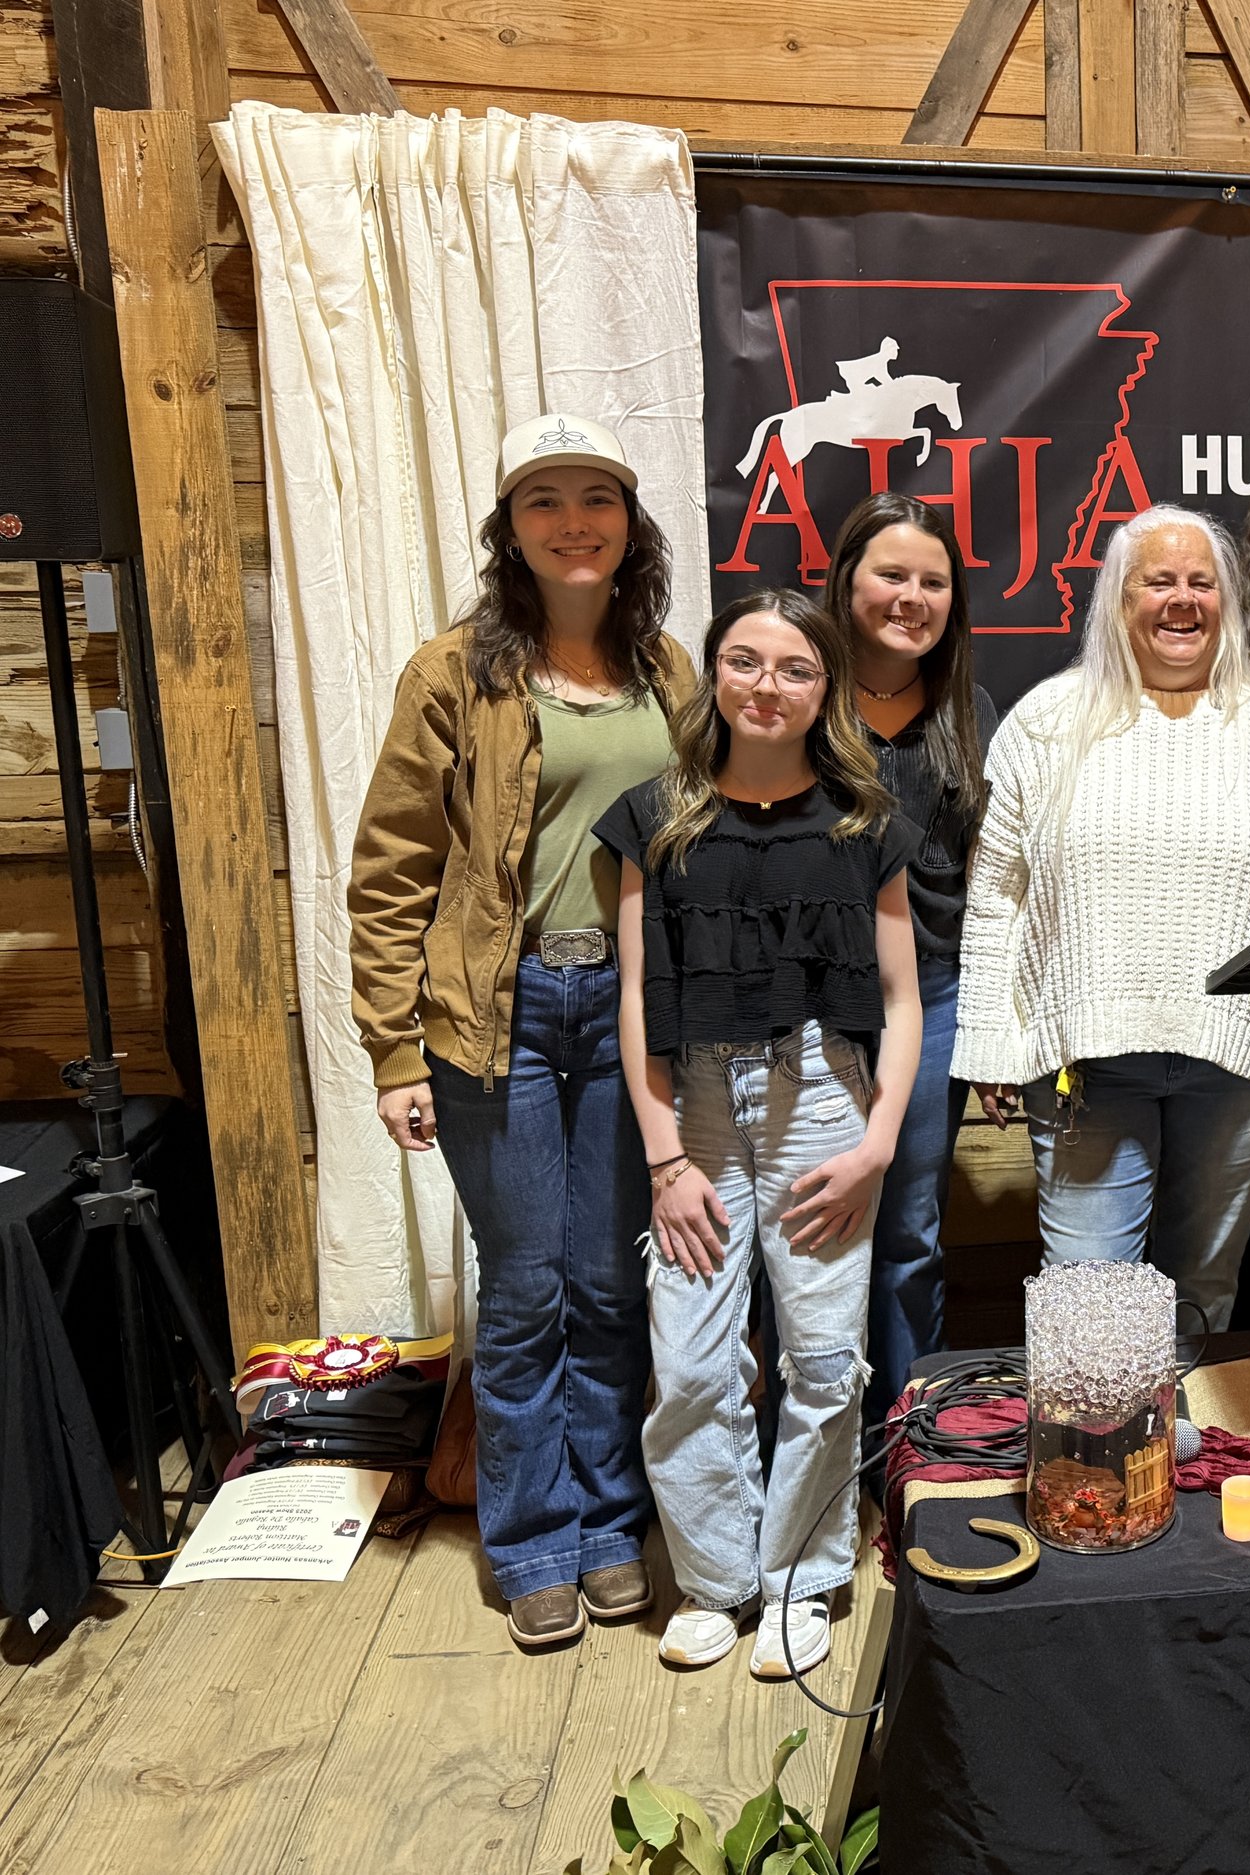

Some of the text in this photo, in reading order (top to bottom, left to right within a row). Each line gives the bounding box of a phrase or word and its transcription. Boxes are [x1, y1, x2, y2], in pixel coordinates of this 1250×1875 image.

[716, 434, 1154, 599] AHJA
[267, 1542, 323, 1552] Certificate
[185, 1556, 229, 1568] Association
[231, 1555, 262, 1563] Jumper
[293, 1556, 333, 1565] Arkansas
